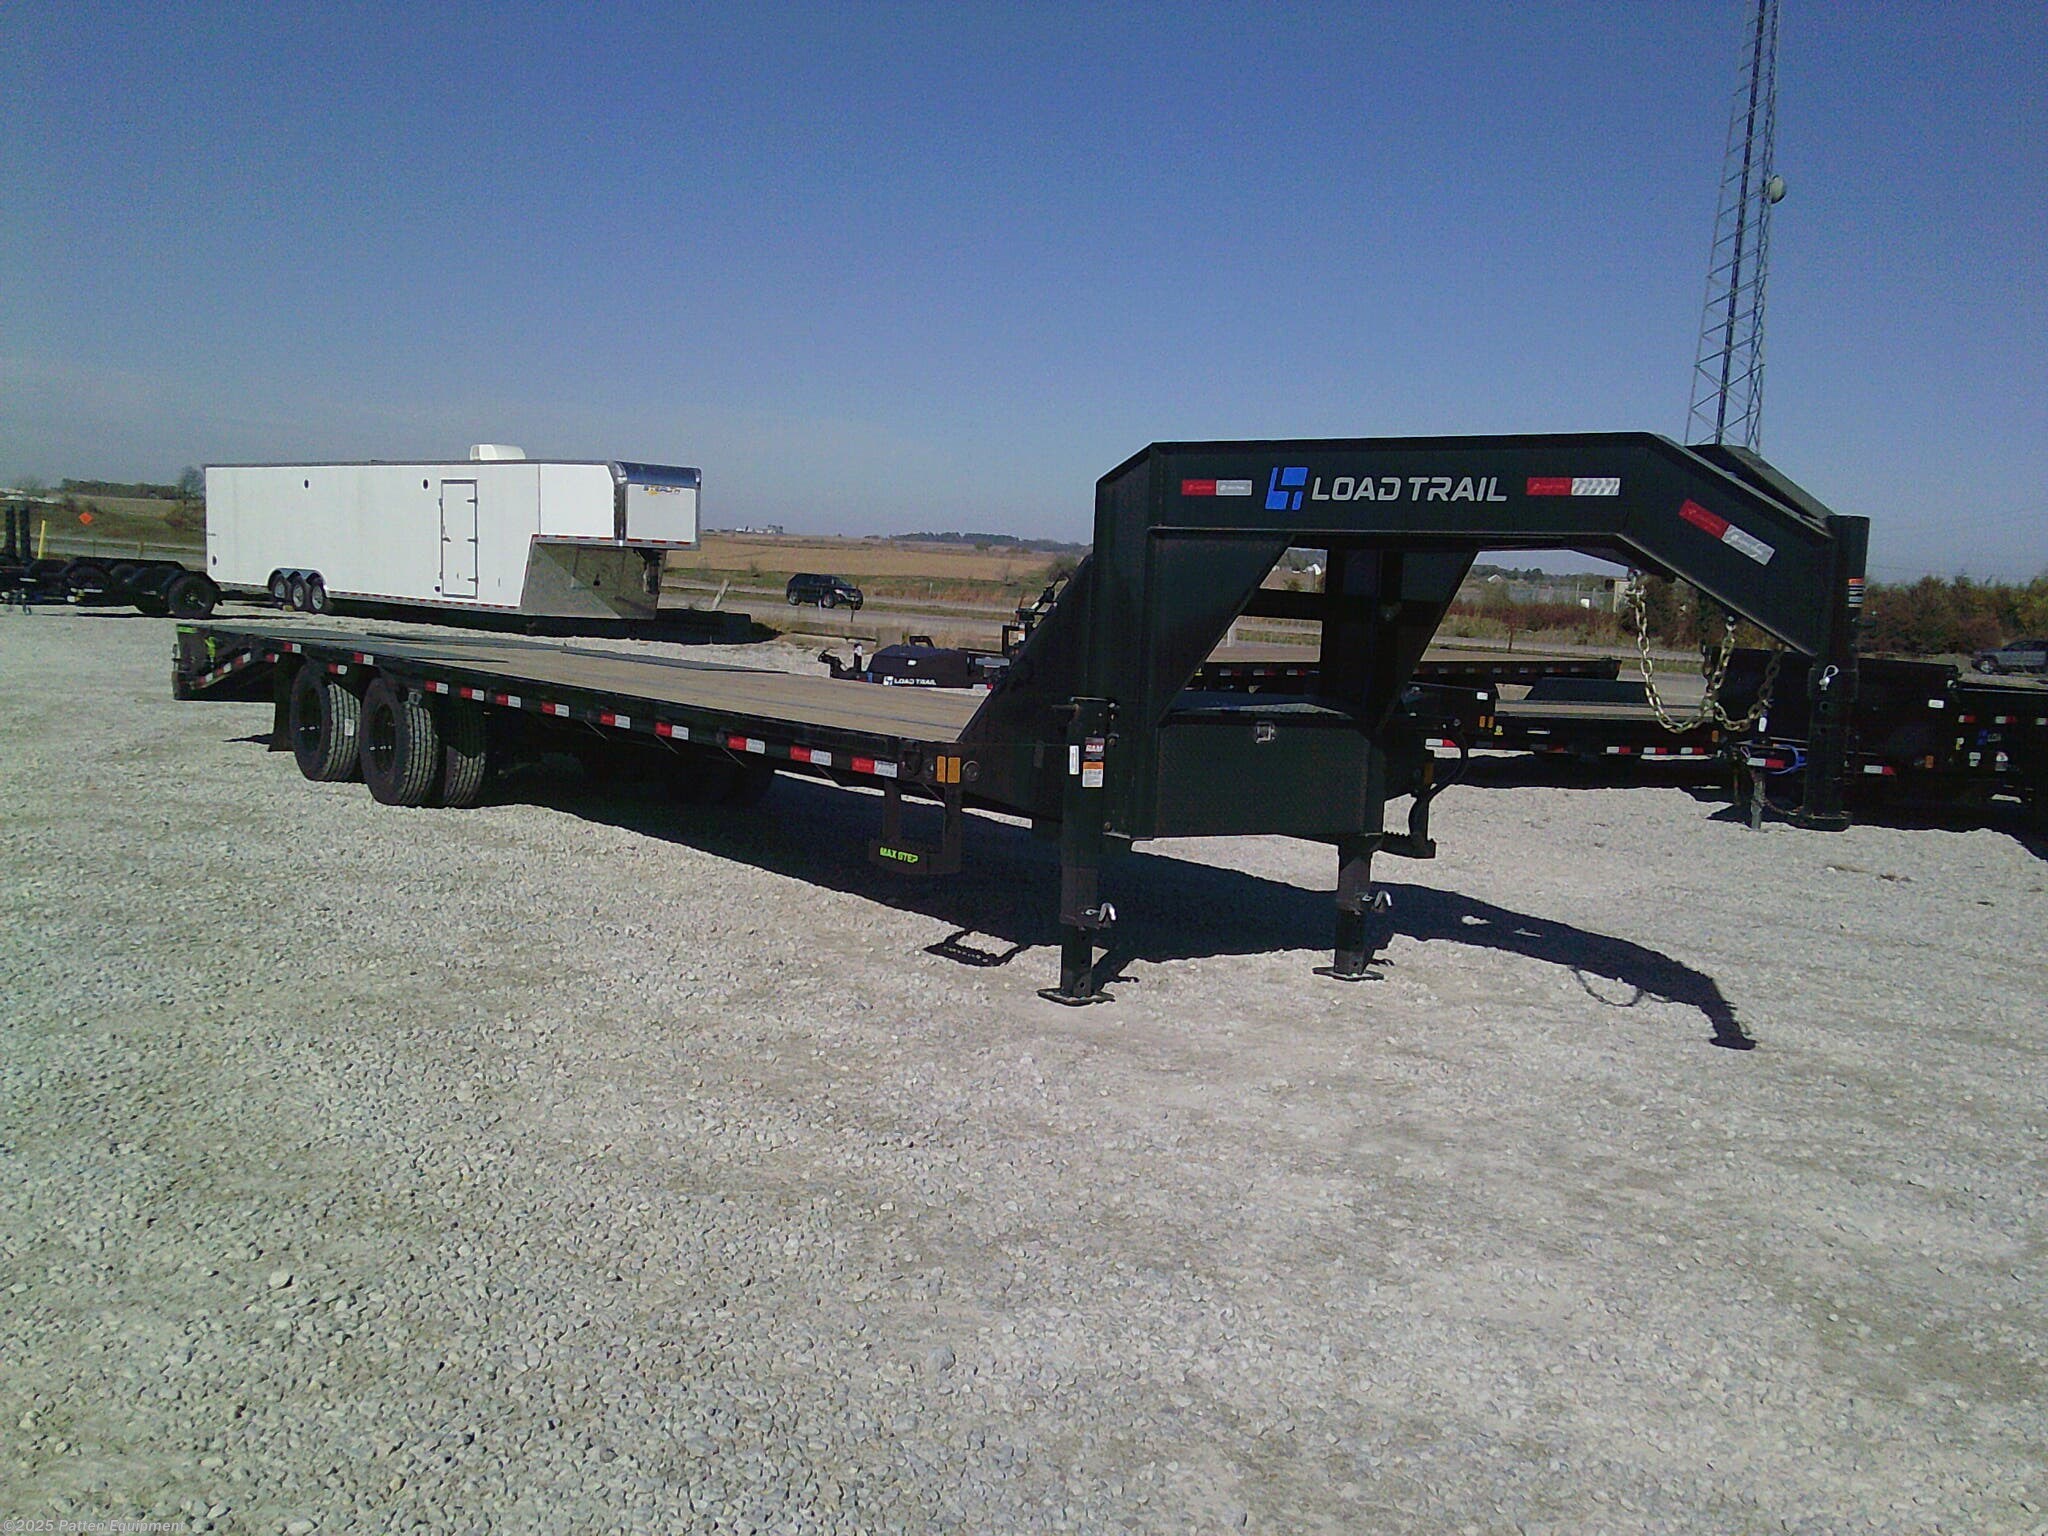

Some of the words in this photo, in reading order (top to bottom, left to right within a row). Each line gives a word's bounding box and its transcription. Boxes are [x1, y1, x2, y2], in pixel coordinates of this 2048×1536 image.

[1311, 477, 1401, 501] LOAD
[1408, 477, 1507, 502] TRAIL
[915, 678, 937, 686] TRAIL
[880, 847, 897, 859] MAX
[897, 851, 919, 863] STEP
